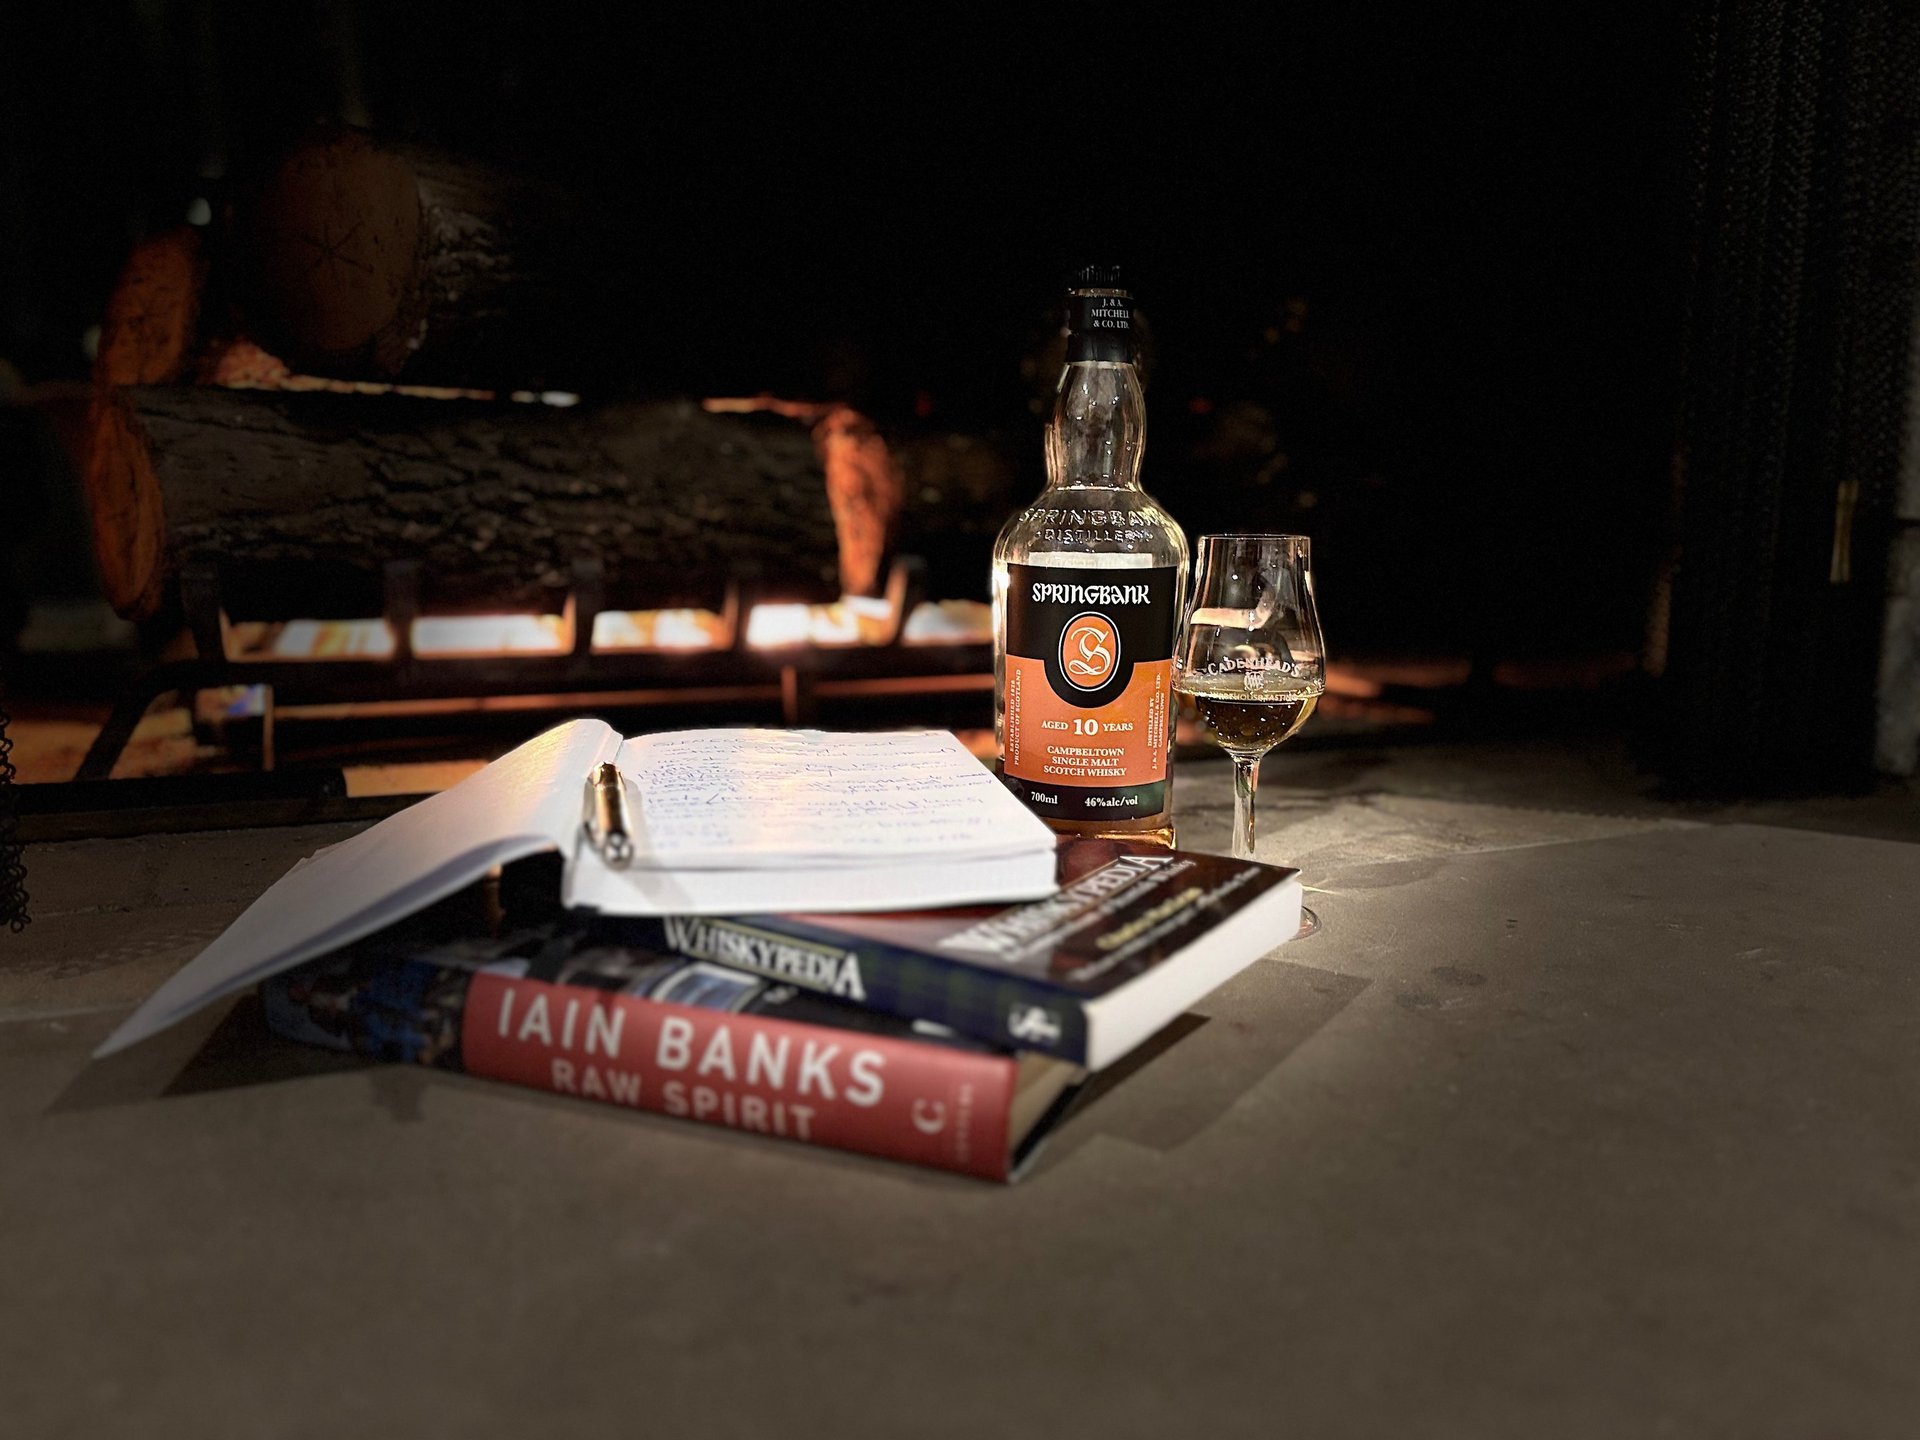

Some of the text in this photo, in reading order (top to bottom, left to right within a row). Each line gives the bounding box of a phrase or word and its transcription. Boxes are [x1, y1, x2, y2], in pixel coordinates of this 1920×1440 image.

[1110, 299, 1116, 307] &
[1091, 309, 1130, 319] MITCHELL
[1093, 320, 1101, 328] &
[1102, 320, 1116, 329] CO.
[1018, 507, 1168, 531] SPRINGBAN
[1032, 583, 1151, 605] SPRINGBANK
[1207, 656, 1301, 678] CADENHEAD'S
[1015, 713, 1021, 726] OF
[1041, 718, 1134, 736] AGED 10 YEARS
[1046, 745, 1125, 757] CAMPBELTOWN
[1051, 756, 1120, 767] SINGLE MALT
[1043, 765, 1128, 777] SCOTCH WHISKY
[1030, 791, 1058, 805] 700ml
[1084, 795, 1139, 808] 46%alc/vol
[663, 916, 867, 1001] WHISKYPEDIA
[498, 988, 628, 1058] IAIN
[656, 1017, 886, 1107] BANKS
[550, 1057, 641, 1105] RAW
[664, 1080, 816, 1140] SPIRIT
